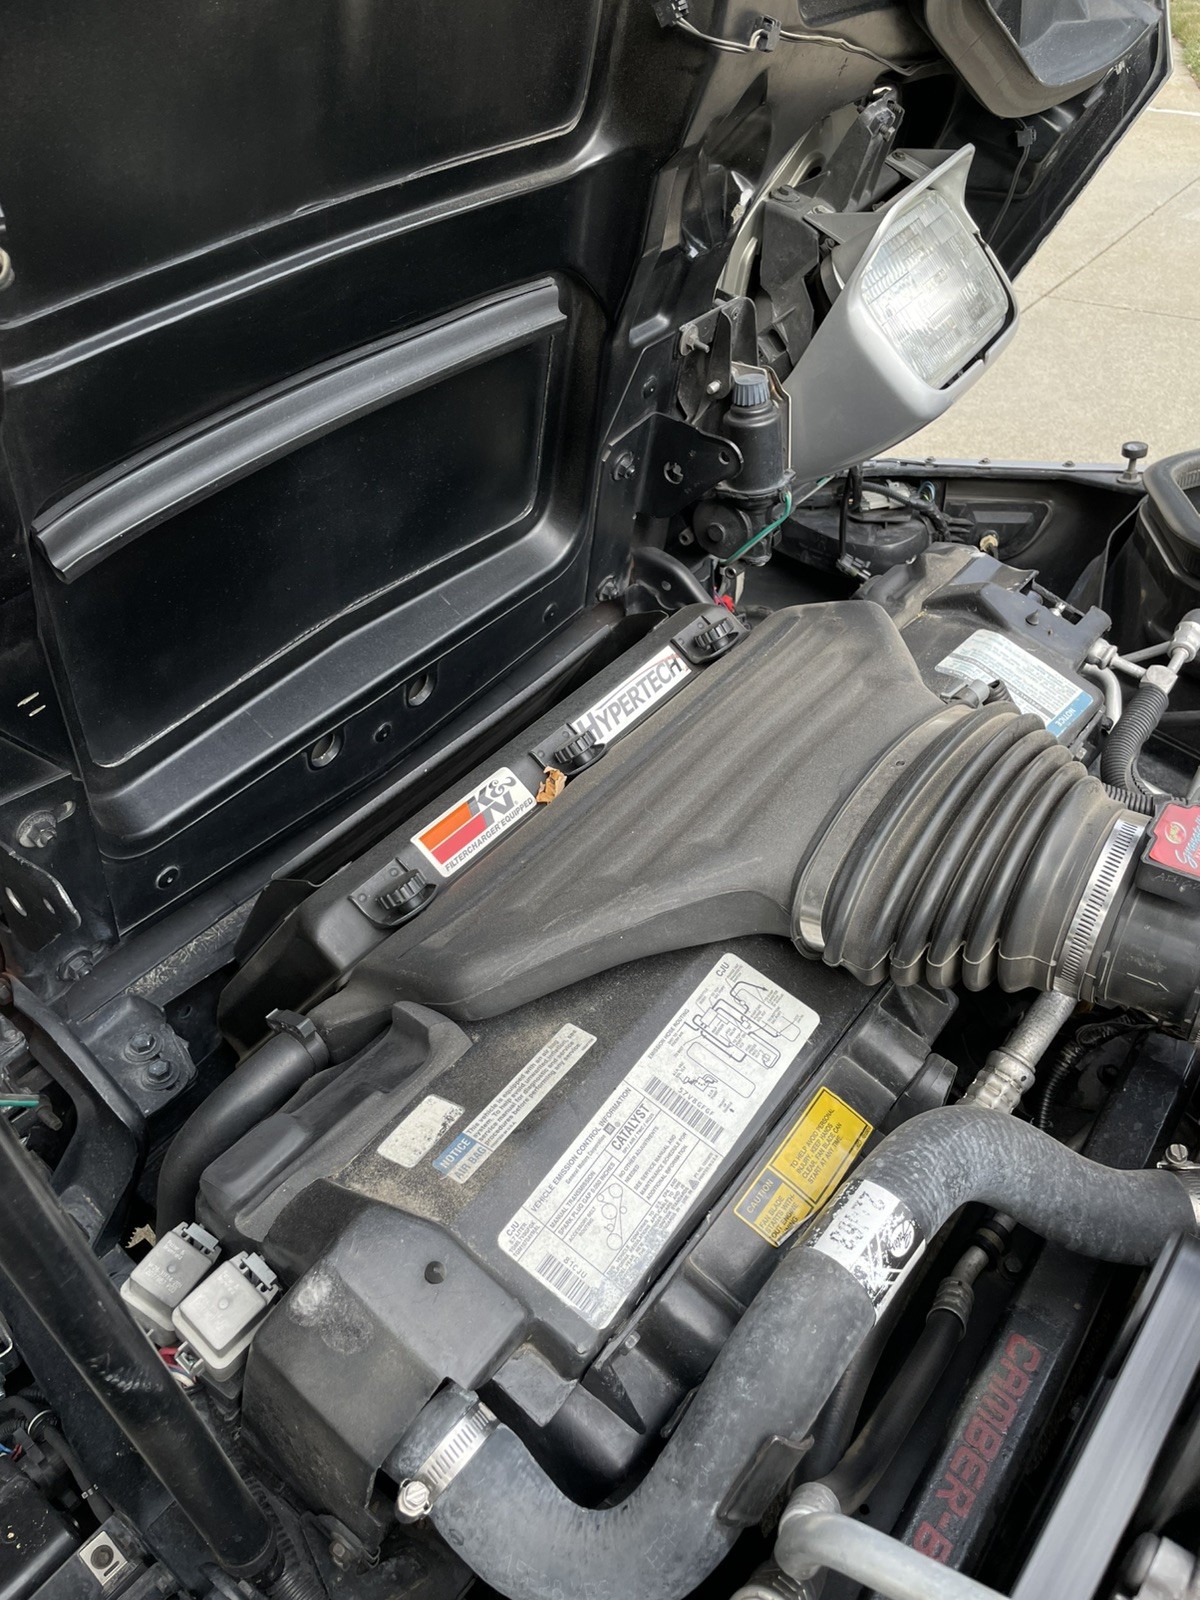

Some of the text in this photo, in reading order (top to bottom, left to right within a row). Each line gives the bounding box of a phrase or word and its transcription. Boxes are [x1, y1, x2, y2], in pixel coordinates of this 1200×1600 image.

[575, 653, 682, 739] HYPERTECH
[1054, 706, 1076, 726] NOTICE
[466, 775, 516, 827] K&N
[500, 797, 533, 826] EQUIPPED
[714, 961, 730, 977] CJU
[647, 1037, 666, 1059] EMISSION
[663, 1026, 675, 1039] HOSE
[672, 1007, 690, 1027] ROUTING
[466, 1121, 480, 1134] This
[477, 1102, 498, 1122] vehicle
[501, 1073, 526, 1098] equipped
[523, 1062, 536, 1074] with
[540, 1048, 550, 1056] air
[472, 1116, 494, 1138] system.
[491, 1109, 501, 1117] To
[498, 1097, 513, 1110] help
[509, 1082, 526, 1098] avoid
[523, 1058, 549, 1083] unwanted
[477, 1040, 575, 1142] service manual for diagnostic and service
[483, 1114, 514, 1146] procedures
[511, 1097, 529, 1115] before
[527, 1069, 556, 1098] performing
[553, 1060, 566, 1071] any
[609, 1102, 651, 1151] CATALYST
[790, 1107, 835, 1169] TO HELP AVOID PERSONAL
[809, 1138, 823, 1154] KEEP
[818, 1122, 834, 1141] HANDS
[814, 1147, 825, 1160] FAN
[821, 1131, 837, 1149] BLADE
[832, 1121, 843, 1134] CAN
[438, 1137, 471, 1169] NOTICE
[453, 1145, 487, 1179] AIR BAG
[530, 1183, 555, 1213] VEHICLE
[551, 1153, 579, 1186] EMISSION
[575, 1125, 601, 1156] CONTROL
[598, 1086, 632, 1127] INFORMATION
[617, 1125, 659, 1178] NO OTHER ADJUSTMENTS
[633, 1133, 677, 1190] SEE SERVICE MANUAL AND
[639, 1161, 666, 1195] MAINTENANCE
[663, 1140, 681, 1162] SCHEDULE
[678, 1131, 687, 1142] FOR
[806, 1165, 823, 1184] START
[818, 1157, 828, 1167] AT
[823, 1146, 835, 1159] ANY
[564, 1167, 580, 1185] General
[576, 1154, 590, 1169] Motors
[624, 1163, 640, 1183] NEEDED
[645, 1173, 667, 1200] ADDITIONAL
[549, 1170, 596, 1229] MANUAL TRANSMISSION
[557, 1215, 574, 1236] SPARK
[570, 1202, 584, 1218] PLUG
[581, 1191, 592, 1204] GAP
[599, 1161, 616, 1181] INCHES
[745, 1178, 774, 1214] CAUTION
[758, 1194, 785, 1229] FAN BLADE
[763, 1192, 796, 1233] STARTS WITH-
[505, 1220, 520, 1237] CJU
[514, 1221, 528, 1237] LITER
[567, 1216, 589, 1243] ACCESSORY
[770, 1201, 800, 1239] OUT ENGINE
[562, 1254, 588, 1280] 81CJU
